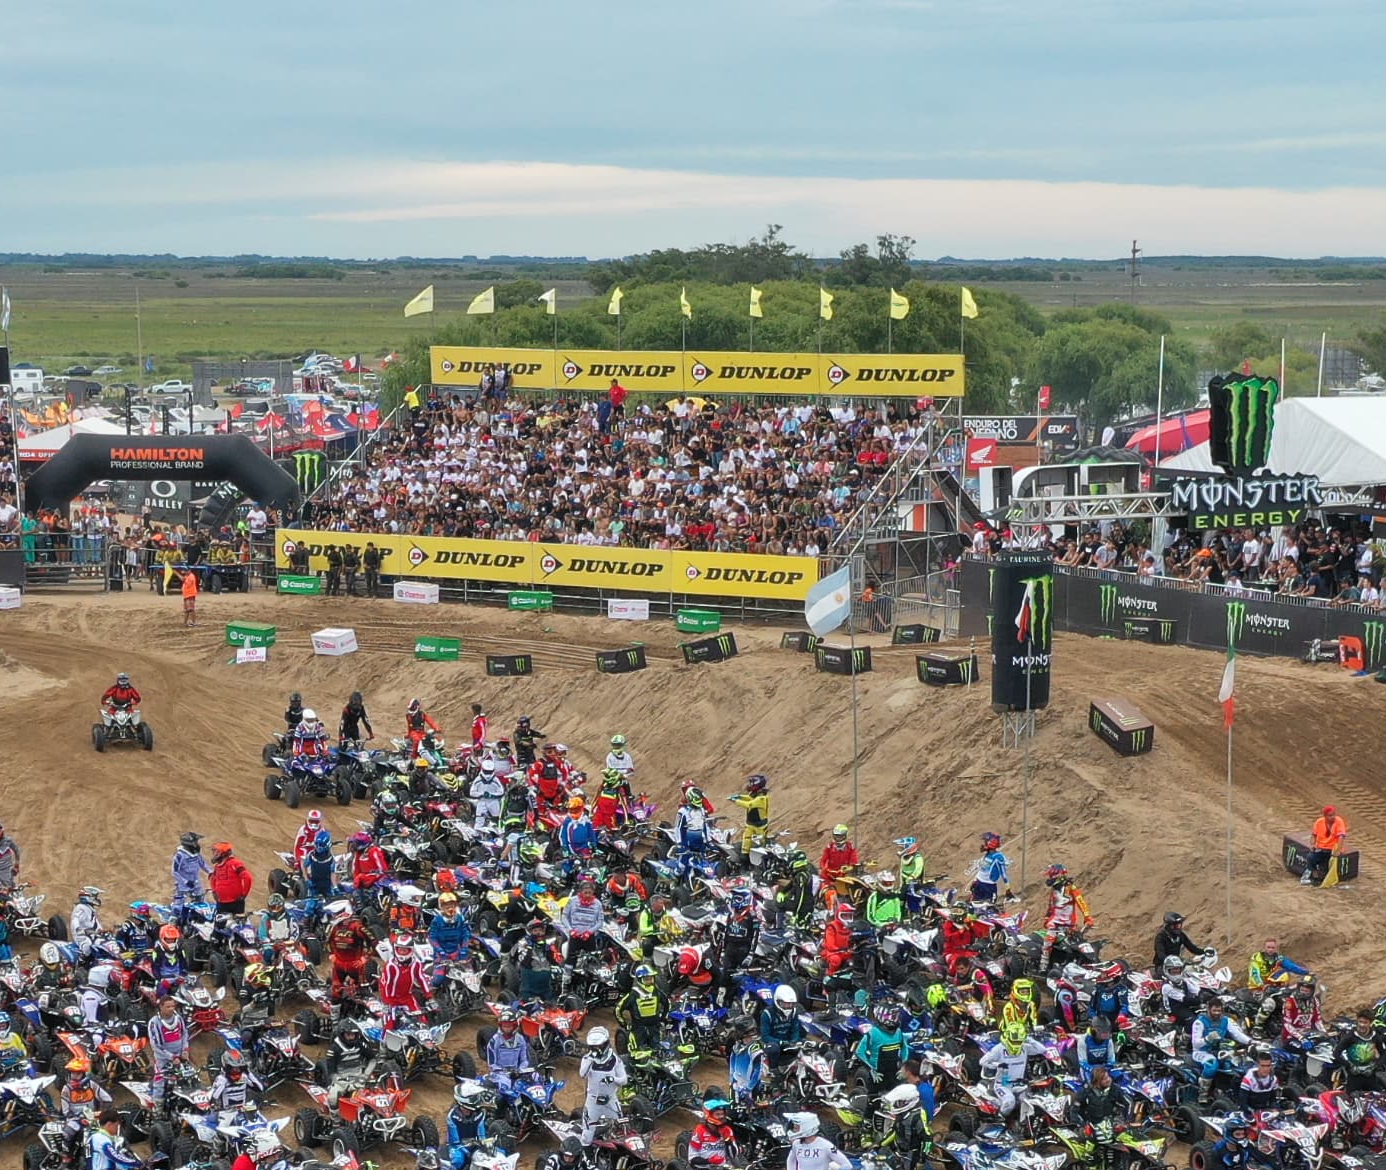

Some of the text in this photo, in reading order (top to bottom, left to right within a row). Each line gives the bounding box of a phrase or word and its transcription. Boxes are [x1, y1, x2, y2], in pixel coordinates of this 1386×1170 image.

[588, 364, 676, 377] DUNLOP
[718, 367, 811, 379] DUNLOP
[855, 369, 954, 382] DUNLOP
[964, 420, 1017, 428] ENDURO DEL
[110, 448, 204, 460] HAMILTON
[110, 461, 204, 469] PROFESSIONAL BRAND
[1172, 475, 1321, 508] MONSTER
[145, 498, 183, 510] OAKLEY
[1195, 509, 1301, 529] ENERGY
[433, 551, 524, 567] DUNLOP
[568, 559, 663, 576] DUNLOP
[704, 567, 803, 584] DUNLOP
[1117, 596, 1157, 611] MONSTER
[1246, 614, 1290, 630] MONSTER
[797, 1148, 821, 1158] FOX
